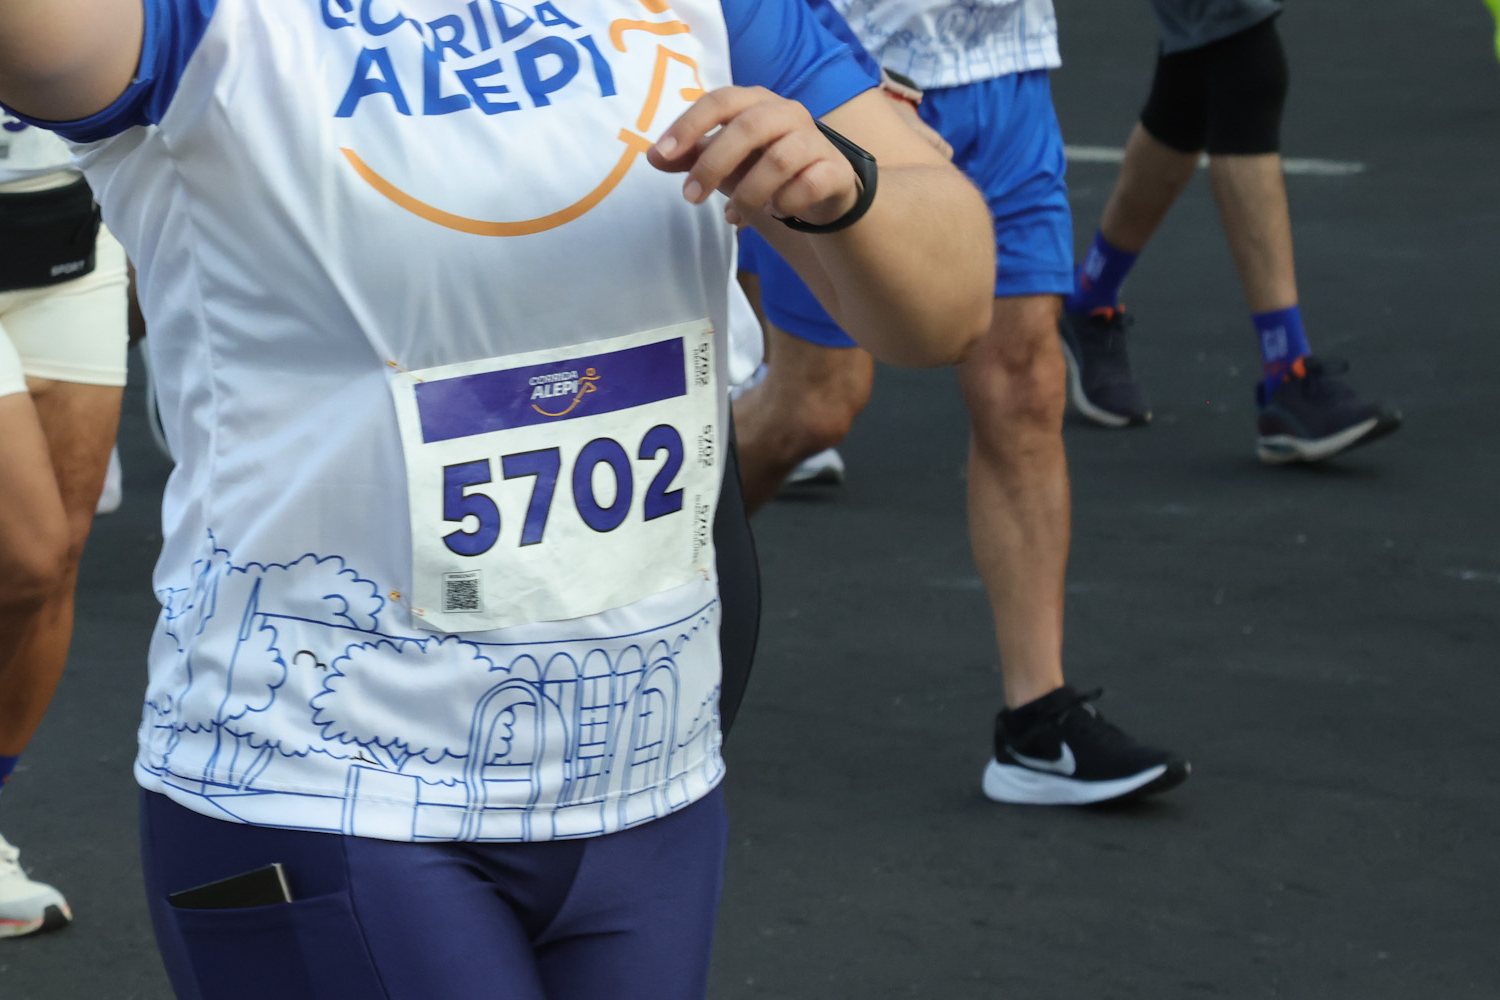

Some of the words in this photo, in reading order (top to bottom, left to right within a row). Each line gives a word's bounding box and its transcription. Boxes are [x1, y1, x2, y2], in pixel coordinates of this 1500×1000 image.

[333, 34, 618, 118] ALEPI
[530, 379, 580, 400] ALEPI
[441, 423, 685, 558] 5702
